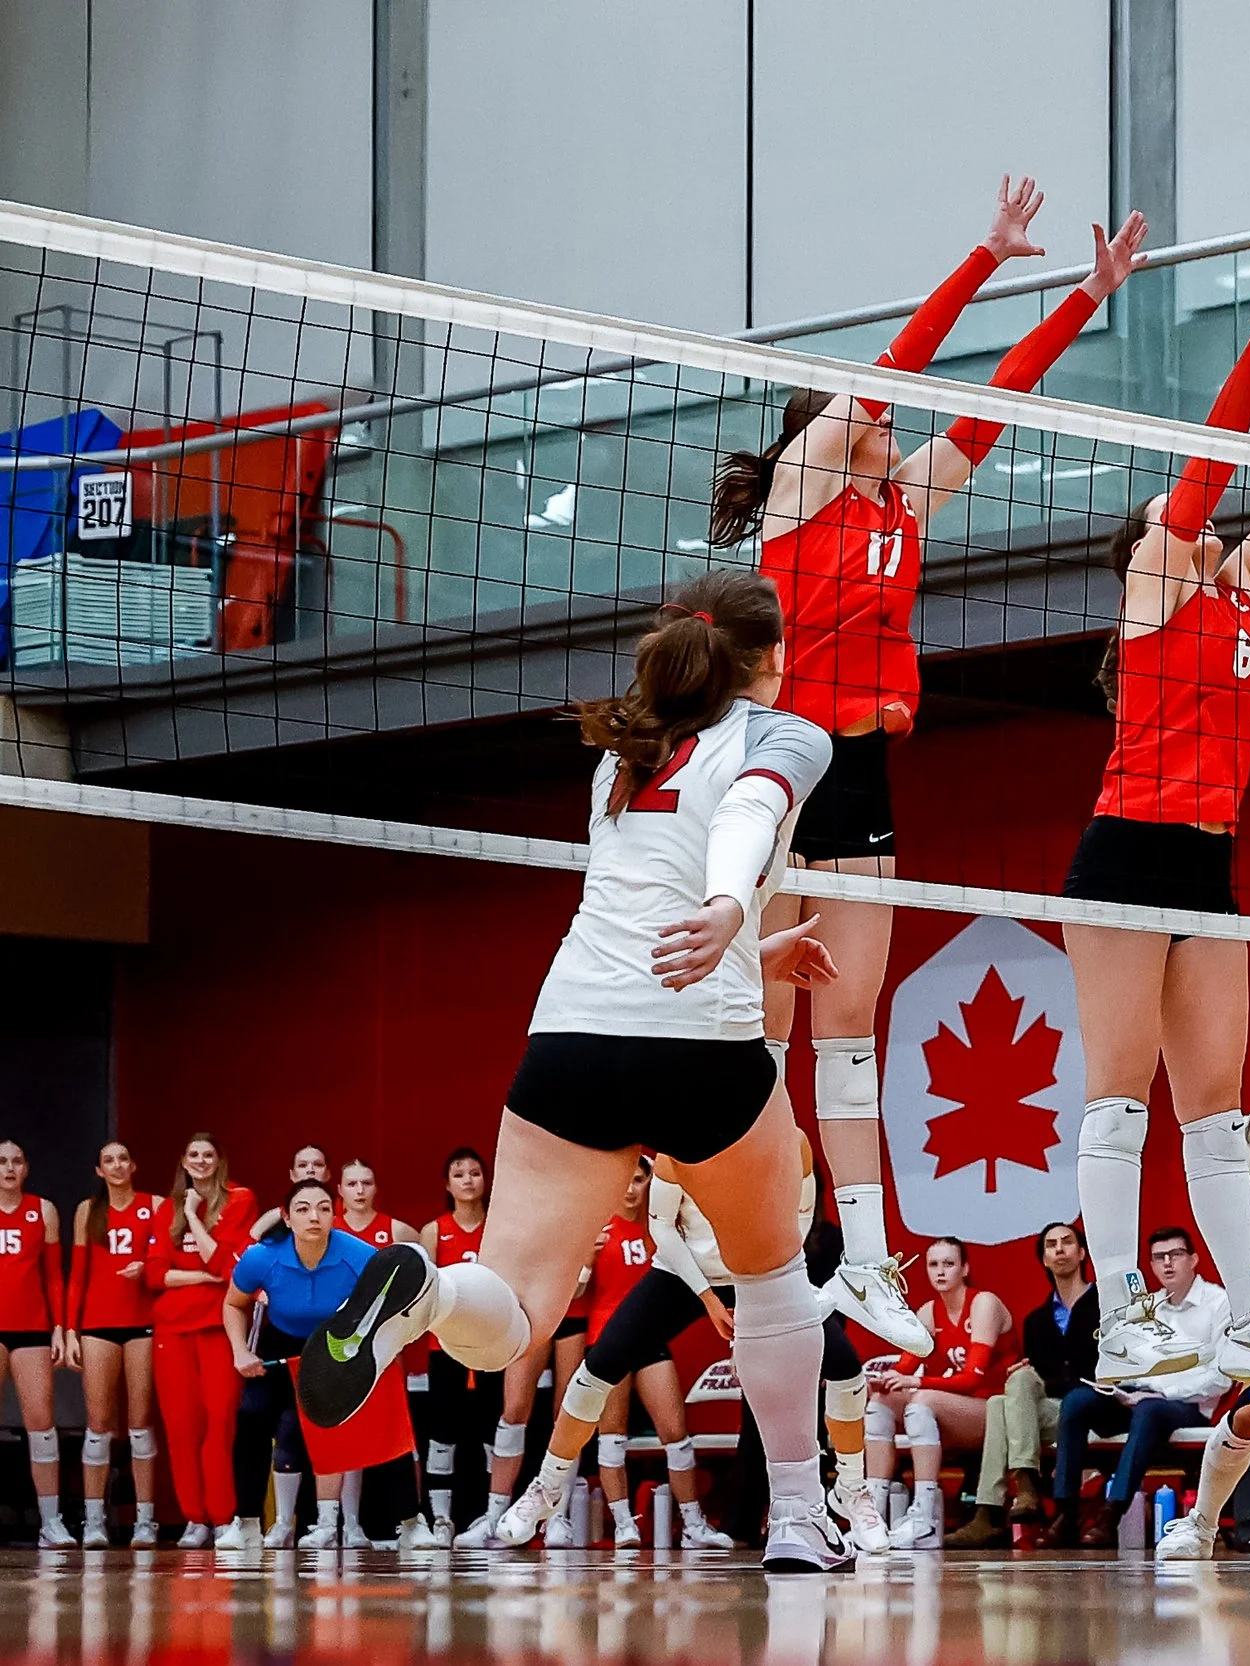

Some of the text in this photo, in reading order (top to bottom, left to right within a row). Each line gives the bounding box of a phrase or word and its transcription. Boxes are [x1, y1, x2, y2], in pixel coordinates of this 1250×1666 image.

[83, 497, 126, 529] 207
[0, 1229, 22, 1254] 15
[107, 1227, 133, 1255] 12
[621, 1238, 647, 1265] 19
